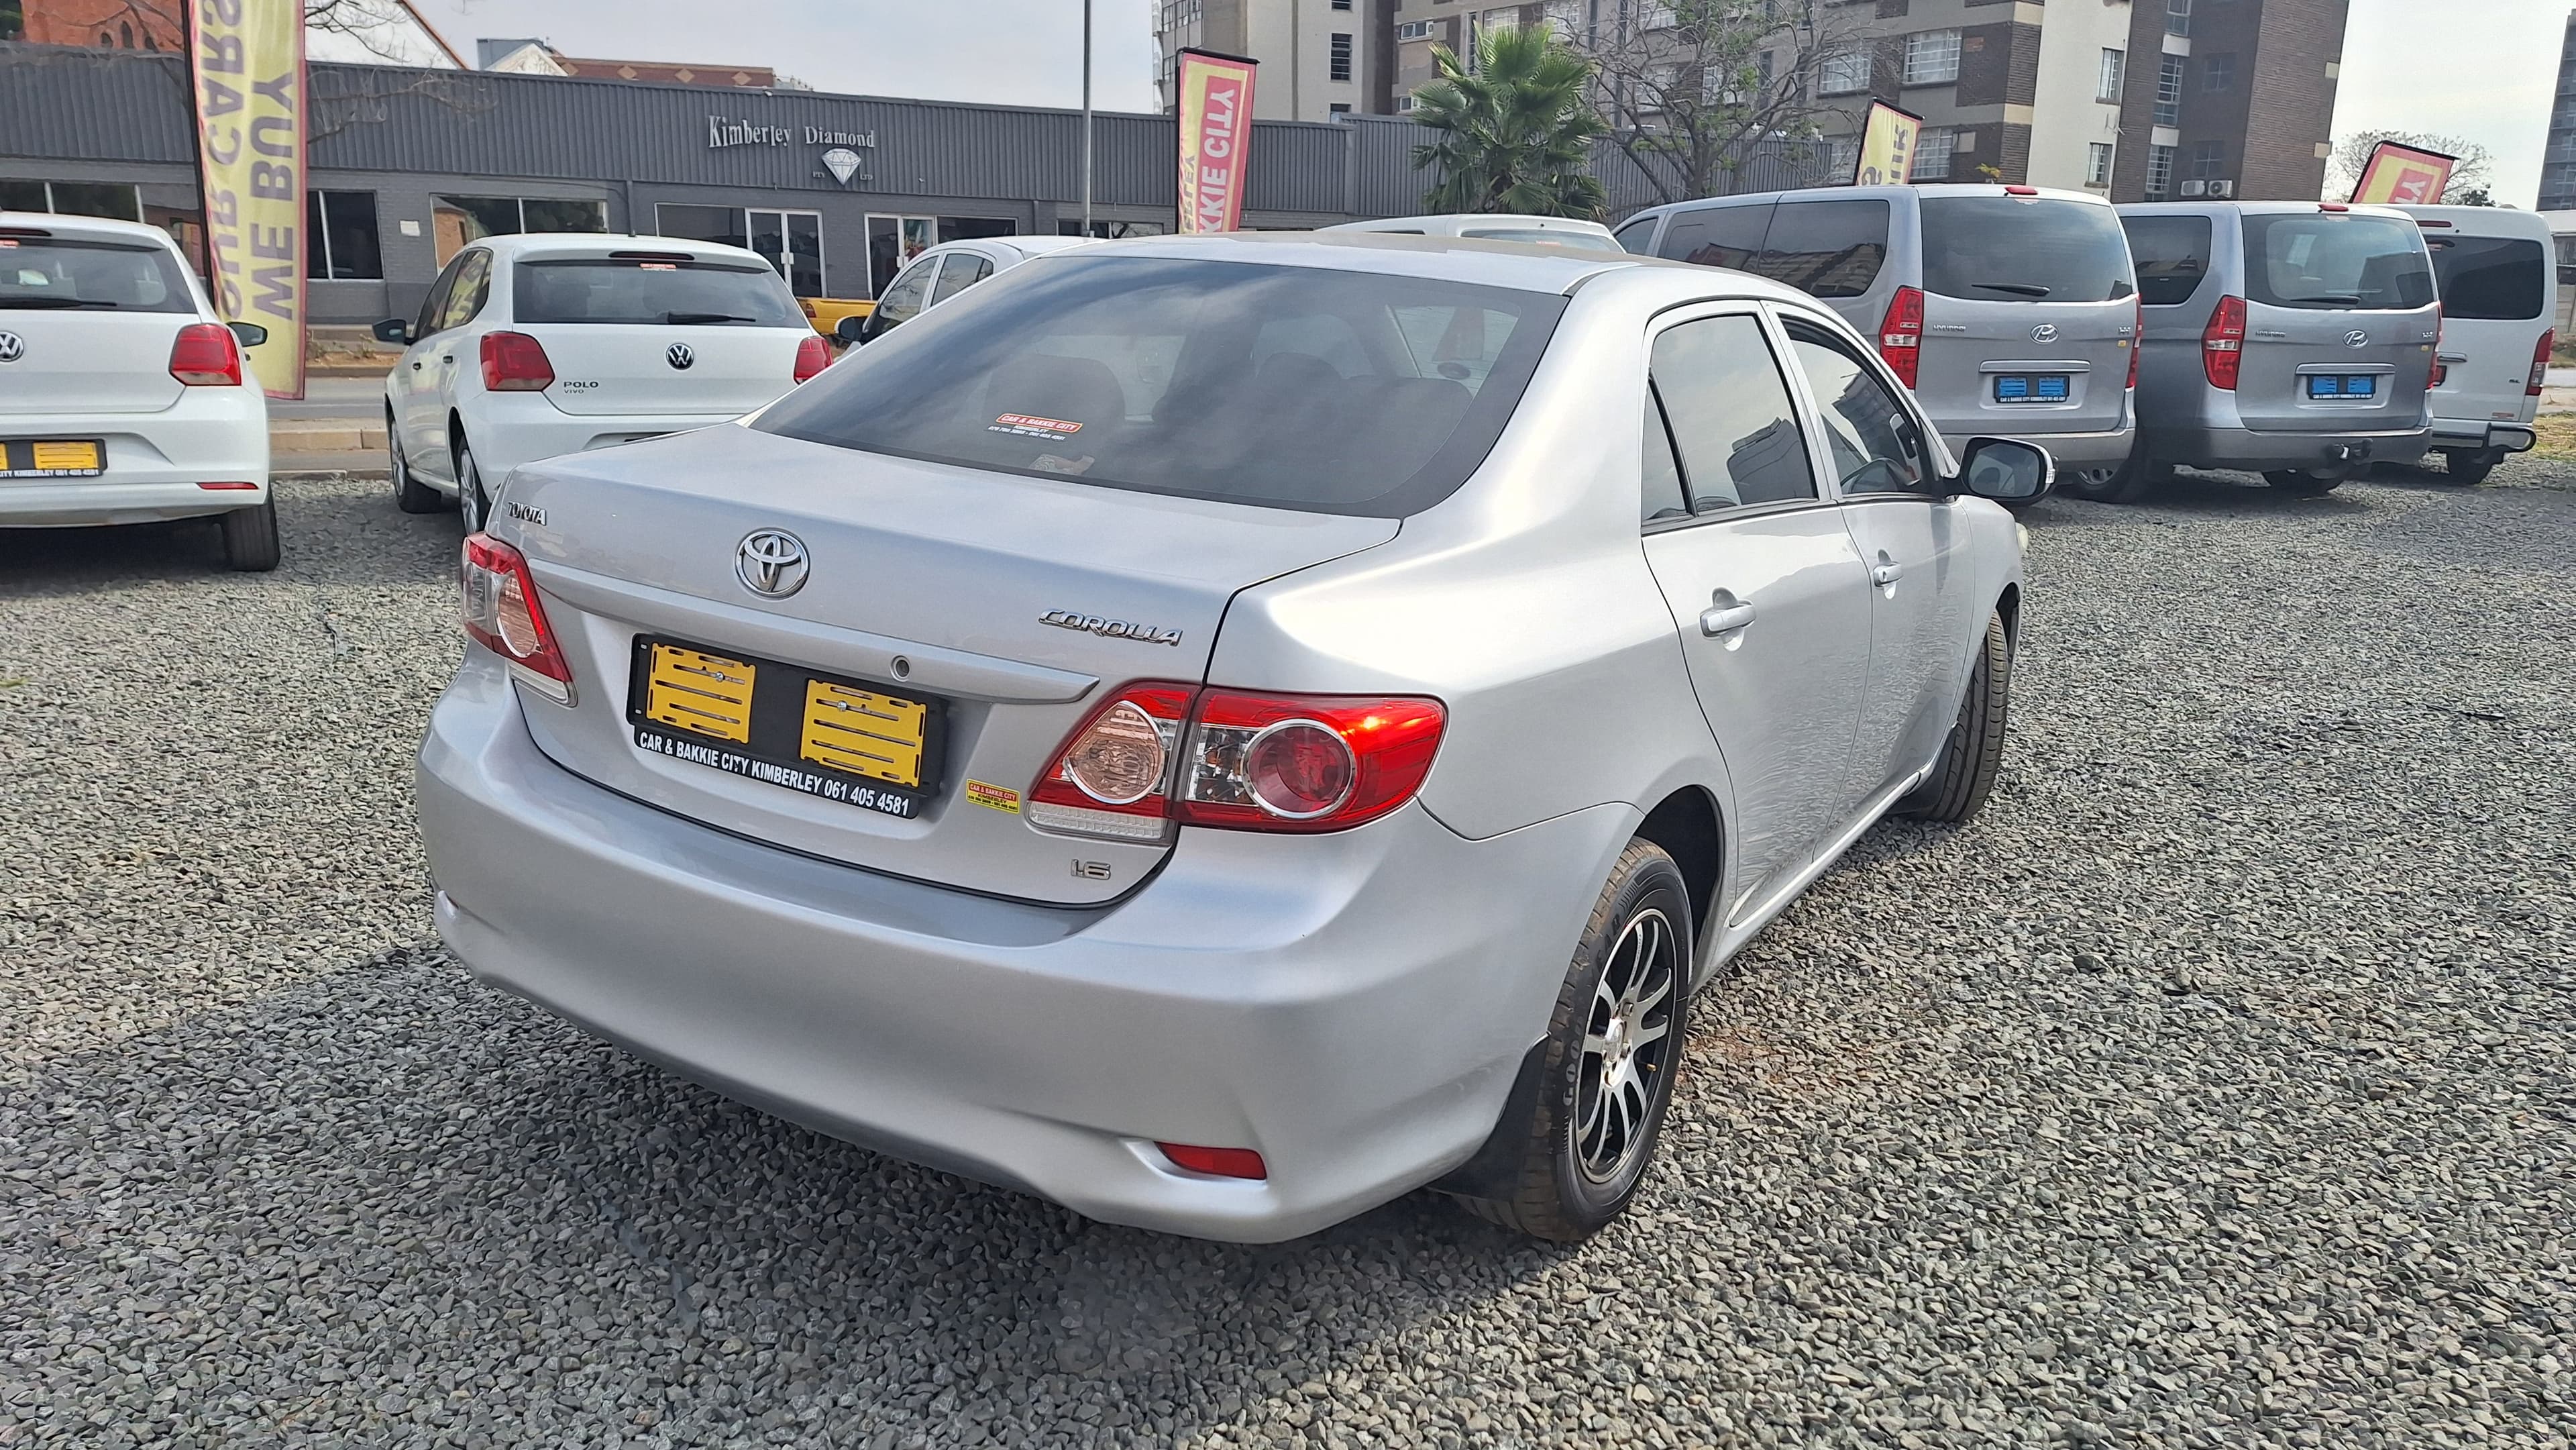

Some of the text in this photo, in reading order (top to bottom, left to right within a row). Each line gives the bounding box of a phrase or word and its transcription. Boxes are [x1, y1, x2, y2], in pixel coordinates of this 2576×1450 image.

[708, 115, 875, 148] Kimberley Diamond
[812, 170, 873, 181] PTY LTD
[1056, 421, 1077, 430] CITY
[508, 501, 547, 526] TOYOTA
[1038, 608, 1183, 646] COROLLA
[639, 731, 910, 816] CAR & BAKKIE CITY KIMBERLEY 061 405 4581
[1004, 792, 1016, 800] CITY
